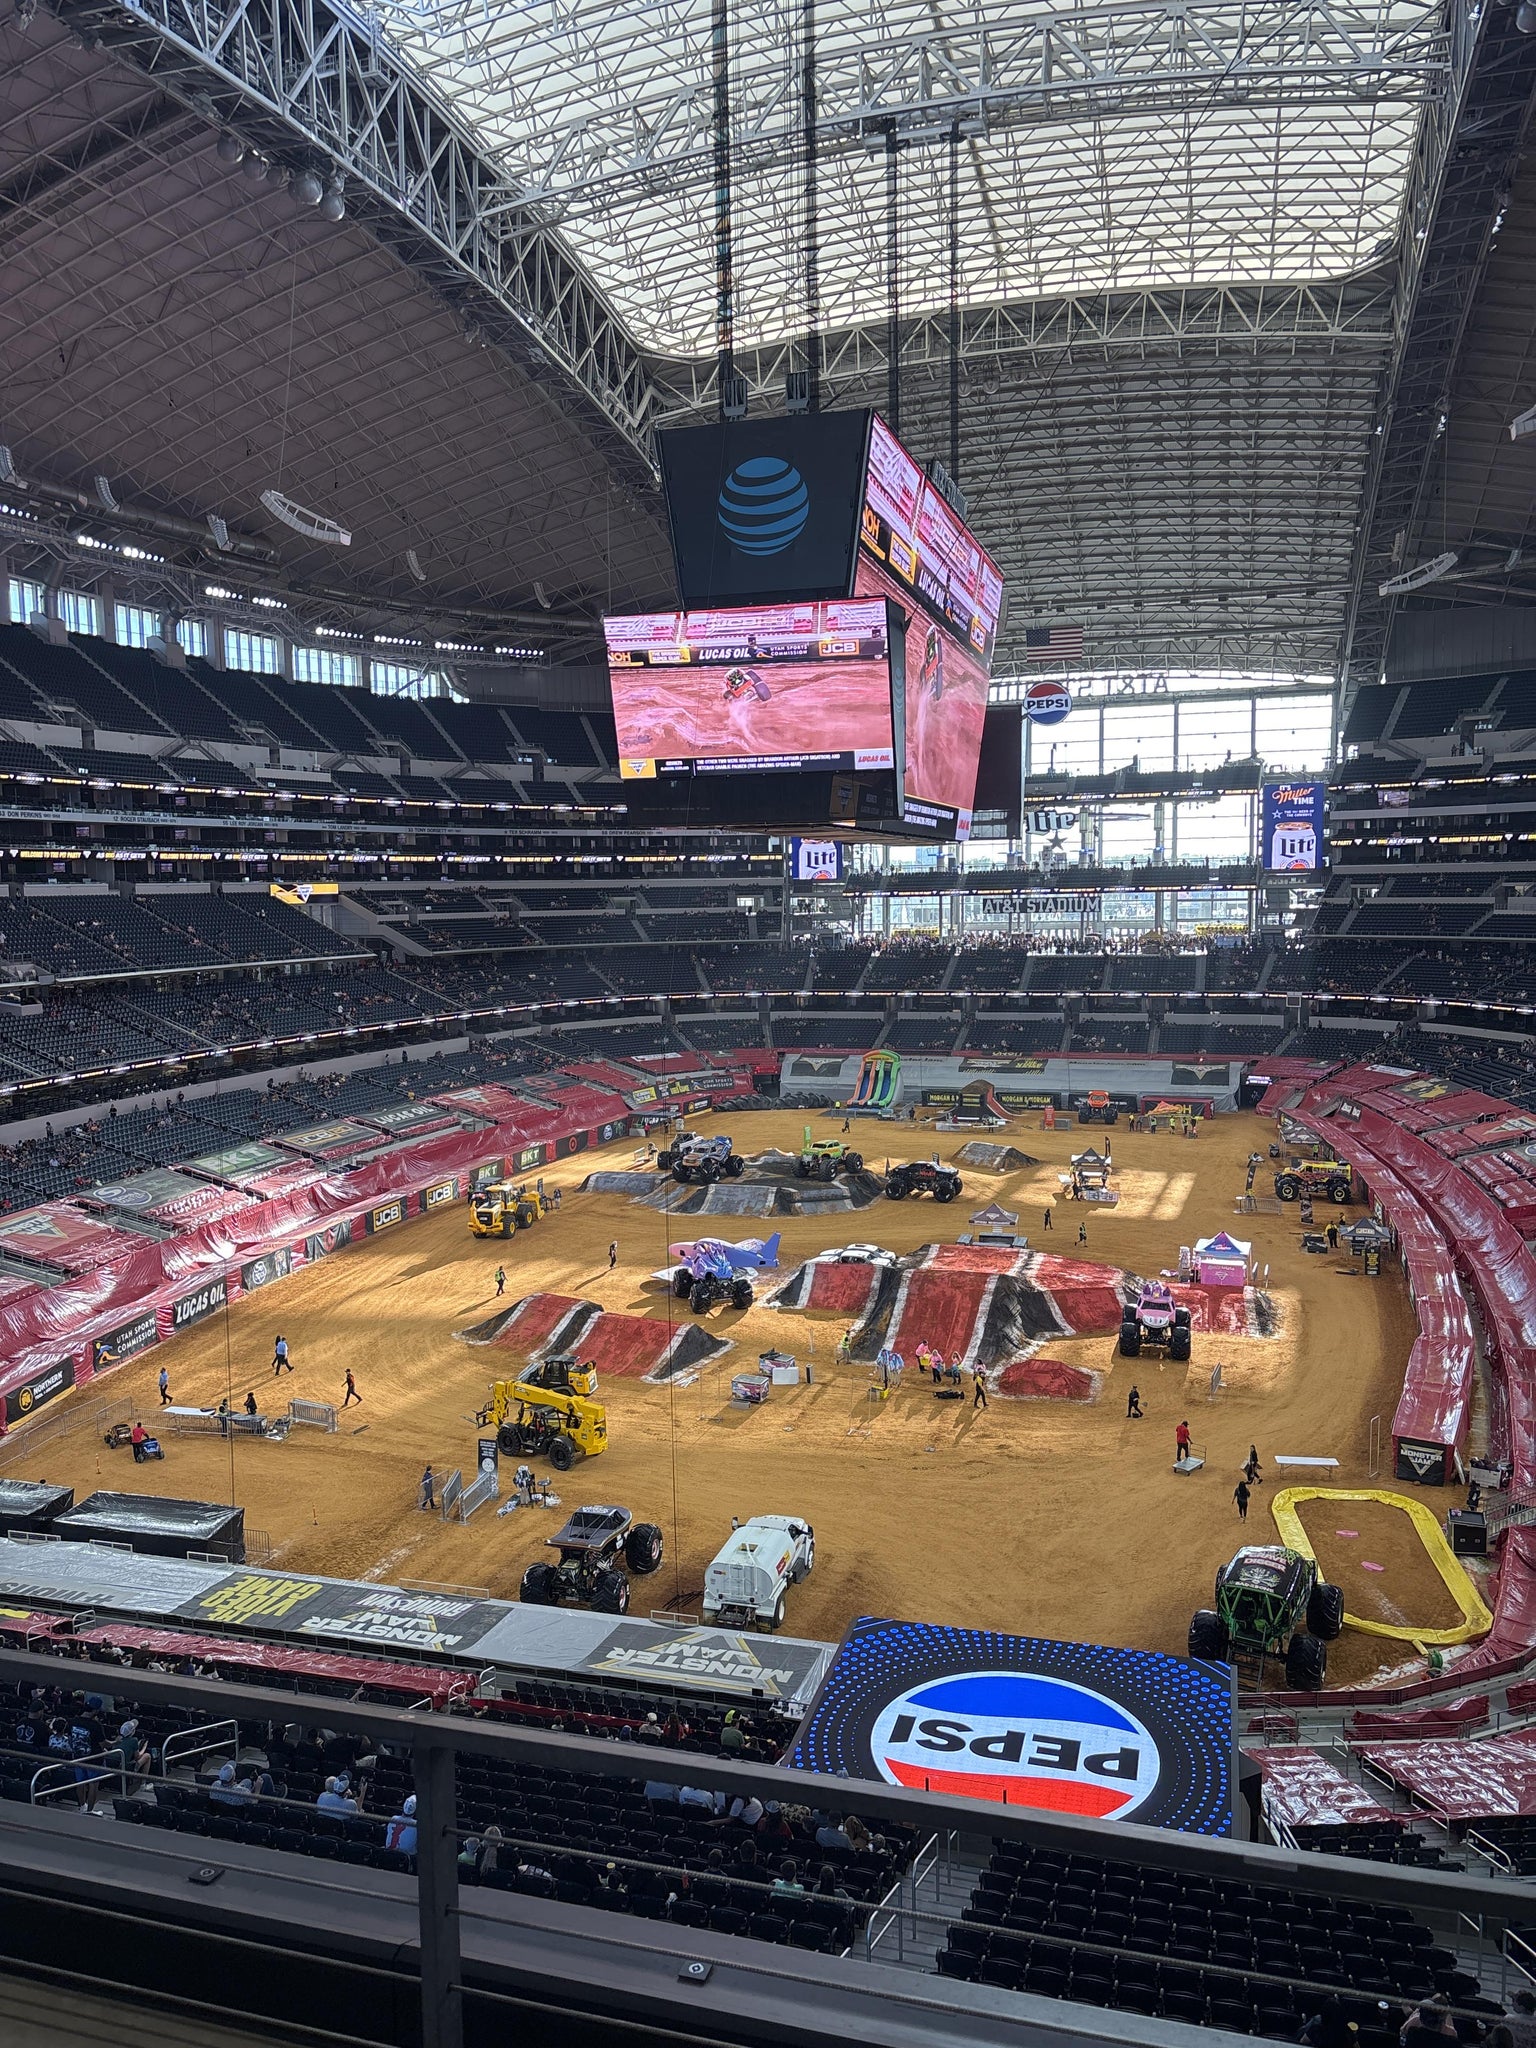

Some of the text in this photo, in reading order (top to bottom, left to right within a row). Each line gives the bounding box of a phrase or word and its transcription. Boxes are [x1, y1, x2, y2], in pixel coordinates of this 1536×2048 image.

[699, 648, 751, 660] LUCAS OIL
[822, 643, 856, 653] JCB
[1026, 699, 1069, 709] PEPSI
[1271, 787, 1315, 805] Miller
[1292, 796, 1315, 805] TIME
[1025, 811, 1076, 836] Lite
[1280, 838, 1315, 858] Lite
[806, 851, 835, 869] Lite
[983, 897, 1100, 914] AT&T STADIUM
[374, 1105, 435, 1125] LUCAS OIL
[521, 1149, 540, 1164] BKT
[478, 1165, 498, 1179] BKT
[428, 1185, 452, 1204] JCB
[375, 1206, 399, 1226] JCB
[176, 1283, 227, 1324] LUCAS OIL
[116, 1317, 156, 1344] UTAH SPORTS
[117, 1327, 156, 1354] COMMISSION
[33, 1370, 64, 1396] NORTHERN
[1400, 1449, 1443, 1462] MONSTER
[1411, 1456, 1432, 1465] JAM
[1243, 1557, 1287, 1574] DIGGER
[227, 1575, 324, 1601] GAME
[200, 1590, 298, 1617] VIDEO
[301, 1615, 464, 1646] MONSTER
[352, 1611, 436, 1633] JAM
[664, 1642, 754, 1663] JAM
[605, 1646, 795, 1684] MONSTER
[887, 1713, 1141, 1782] PEPSI
